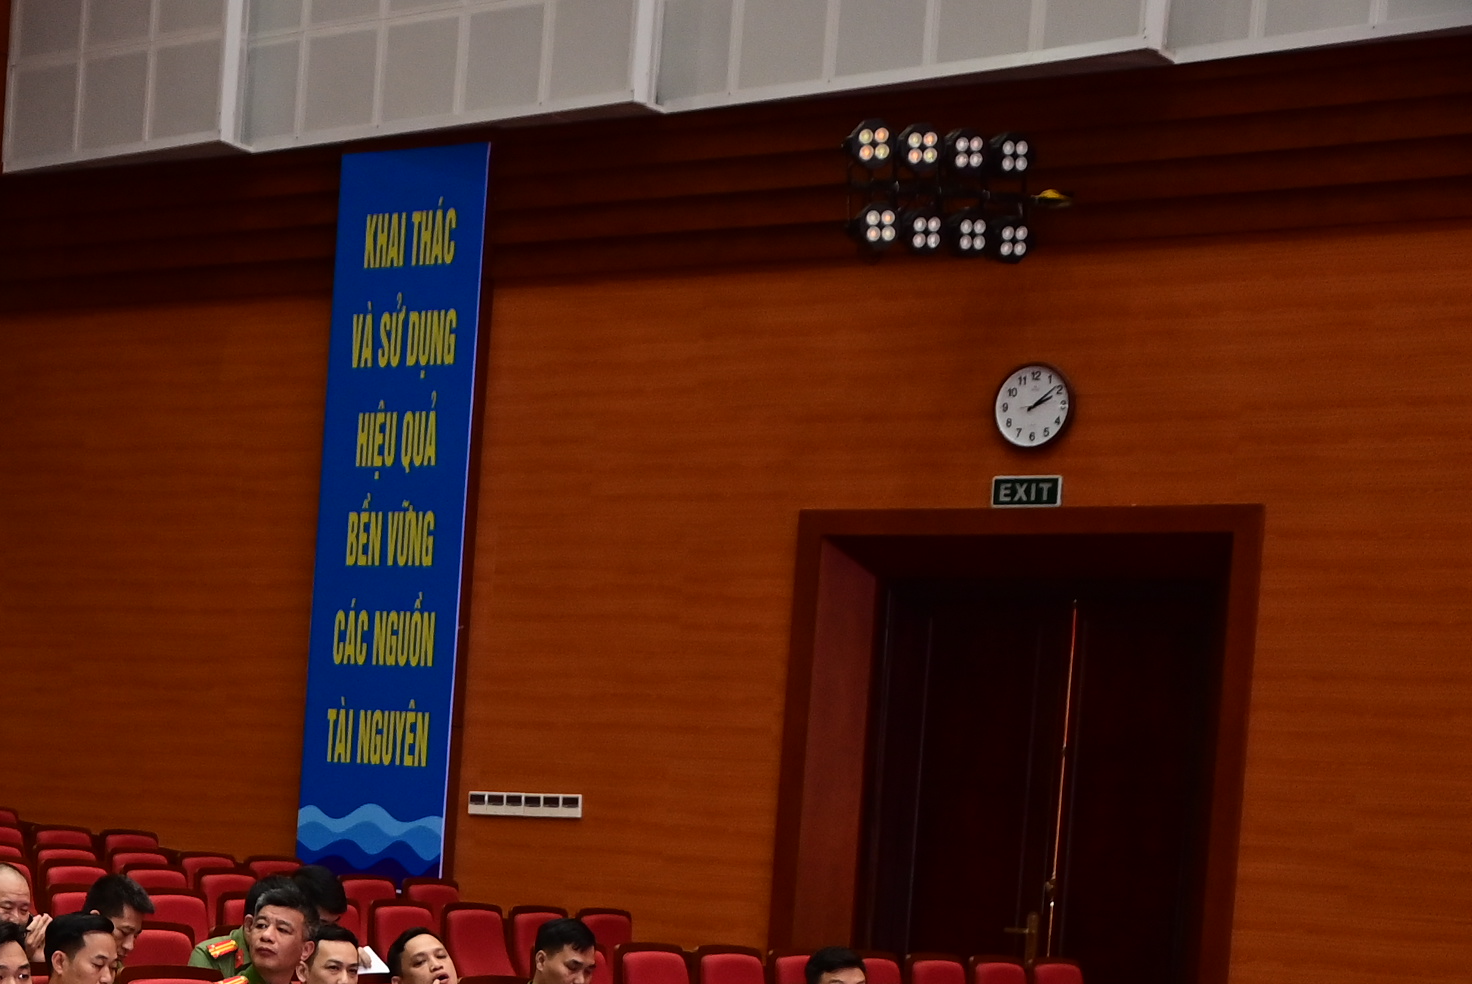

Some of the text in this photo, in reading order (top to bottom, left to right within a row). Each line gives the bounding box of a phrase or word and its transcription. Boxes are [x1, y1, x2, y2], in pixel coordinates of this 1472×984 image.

[364, 196, 457, 268] KHAI THÁC
[352, 292, 457, 379] VÀ SỬ DỤNG
[1018, 375, 1027, 386] 11
[1031, 370, 1041, 381] 12
[1048, 374, 1053, 384] 1
[1007, 387, 1018, 398] 10
[1056, 384, 1064, 395] 2
[1002, 402, 1009, 413] 9
[1005, 417, 1012, 428] 8
[1054, 415, 1061, 426] 4
[355, 391, 437, 480] HIỆU QUẢ
[1016, 427, 1022, 438] 7
[1029, 431, 1036, 442] 6
[1043, 426, 1050, 438] 5
[999, 482, 1053, 502] EXIT
[345, 492, 435, 567] BỀN VỮNG
[333, 592, 436, 667] CÁC NGUỒN
[327, 696, 430, 767] TÀI NGUYÊN
